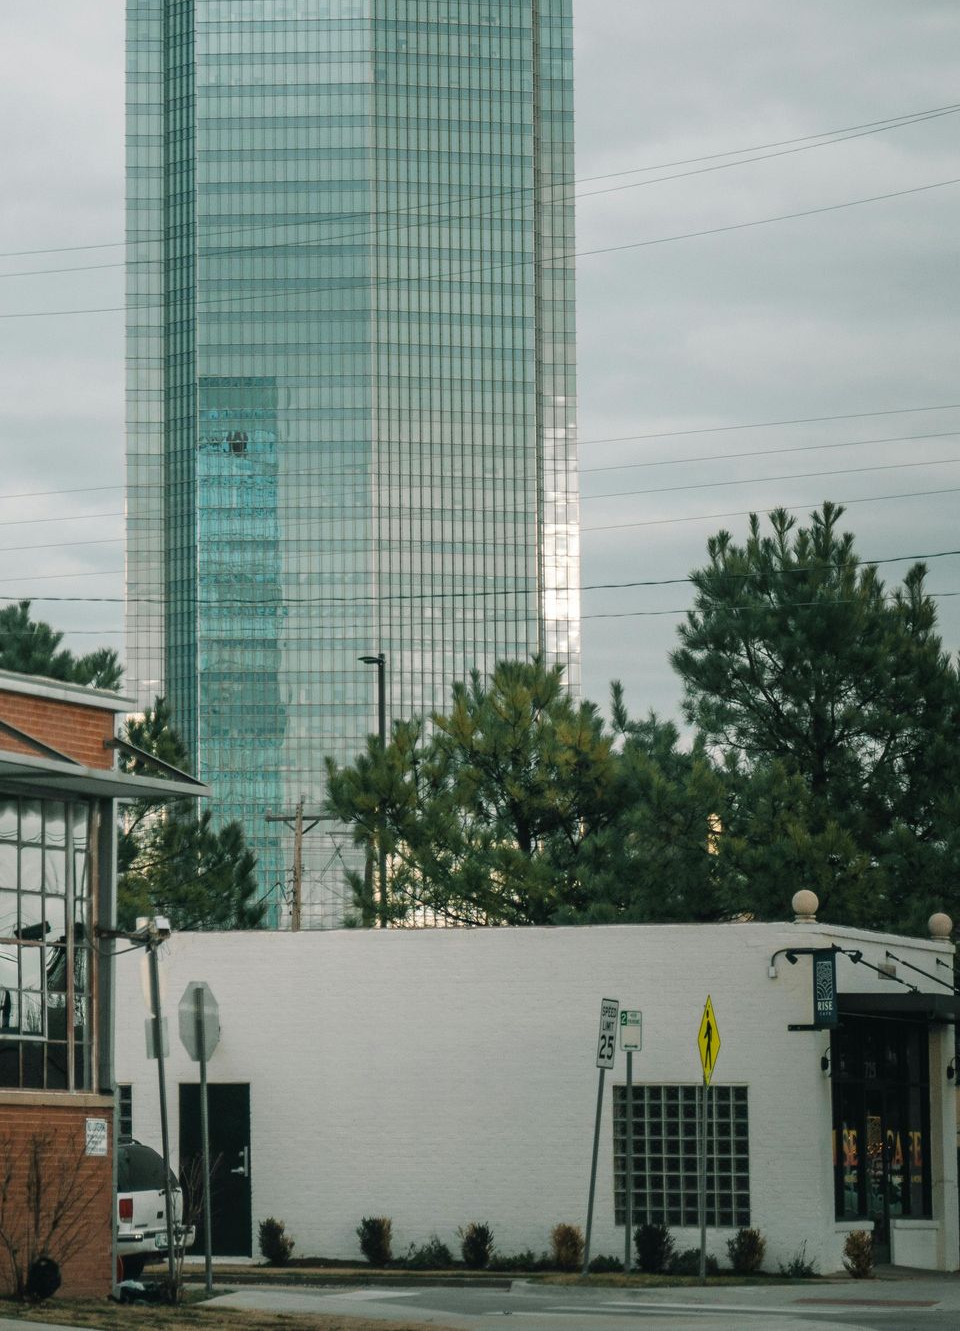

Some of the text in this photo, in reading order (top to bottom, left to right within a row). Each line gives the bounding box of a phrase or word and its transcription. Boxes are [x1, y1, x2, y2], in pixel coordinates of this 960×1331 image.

[602, 1005, 617, 1018] SPEED
[817, 1001, 833, 1011] RISE
[621, 1012, 627, 1024] 2
[602, 1020, 614, 1031] LIMIT
[599, 1035, 614, 1060] 25
